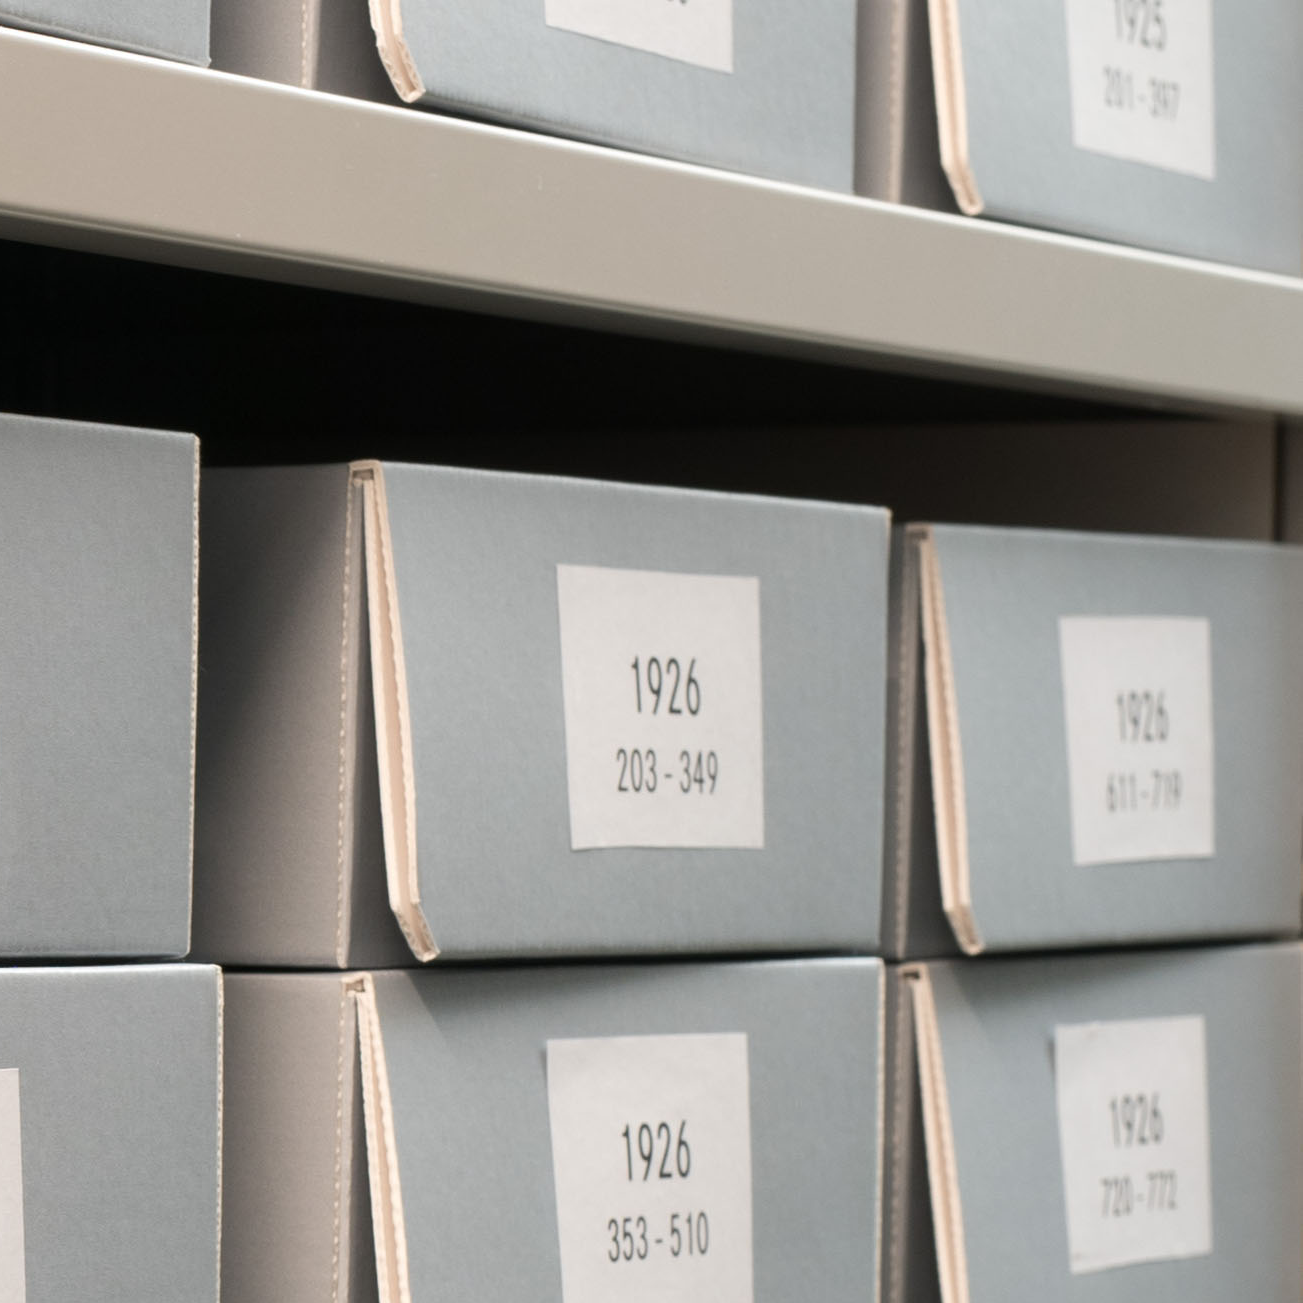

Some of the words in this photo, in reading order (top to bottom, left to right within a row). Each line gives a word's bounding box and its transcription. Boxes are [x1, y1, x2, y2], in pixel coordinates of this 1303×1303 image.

[631, 656, 701, 717] 1926
[1116, 689, 1170, 743] 1926
[1109, 1092, 1165, 1147] 1926
[622, 1120, 691, 1181] 1926
